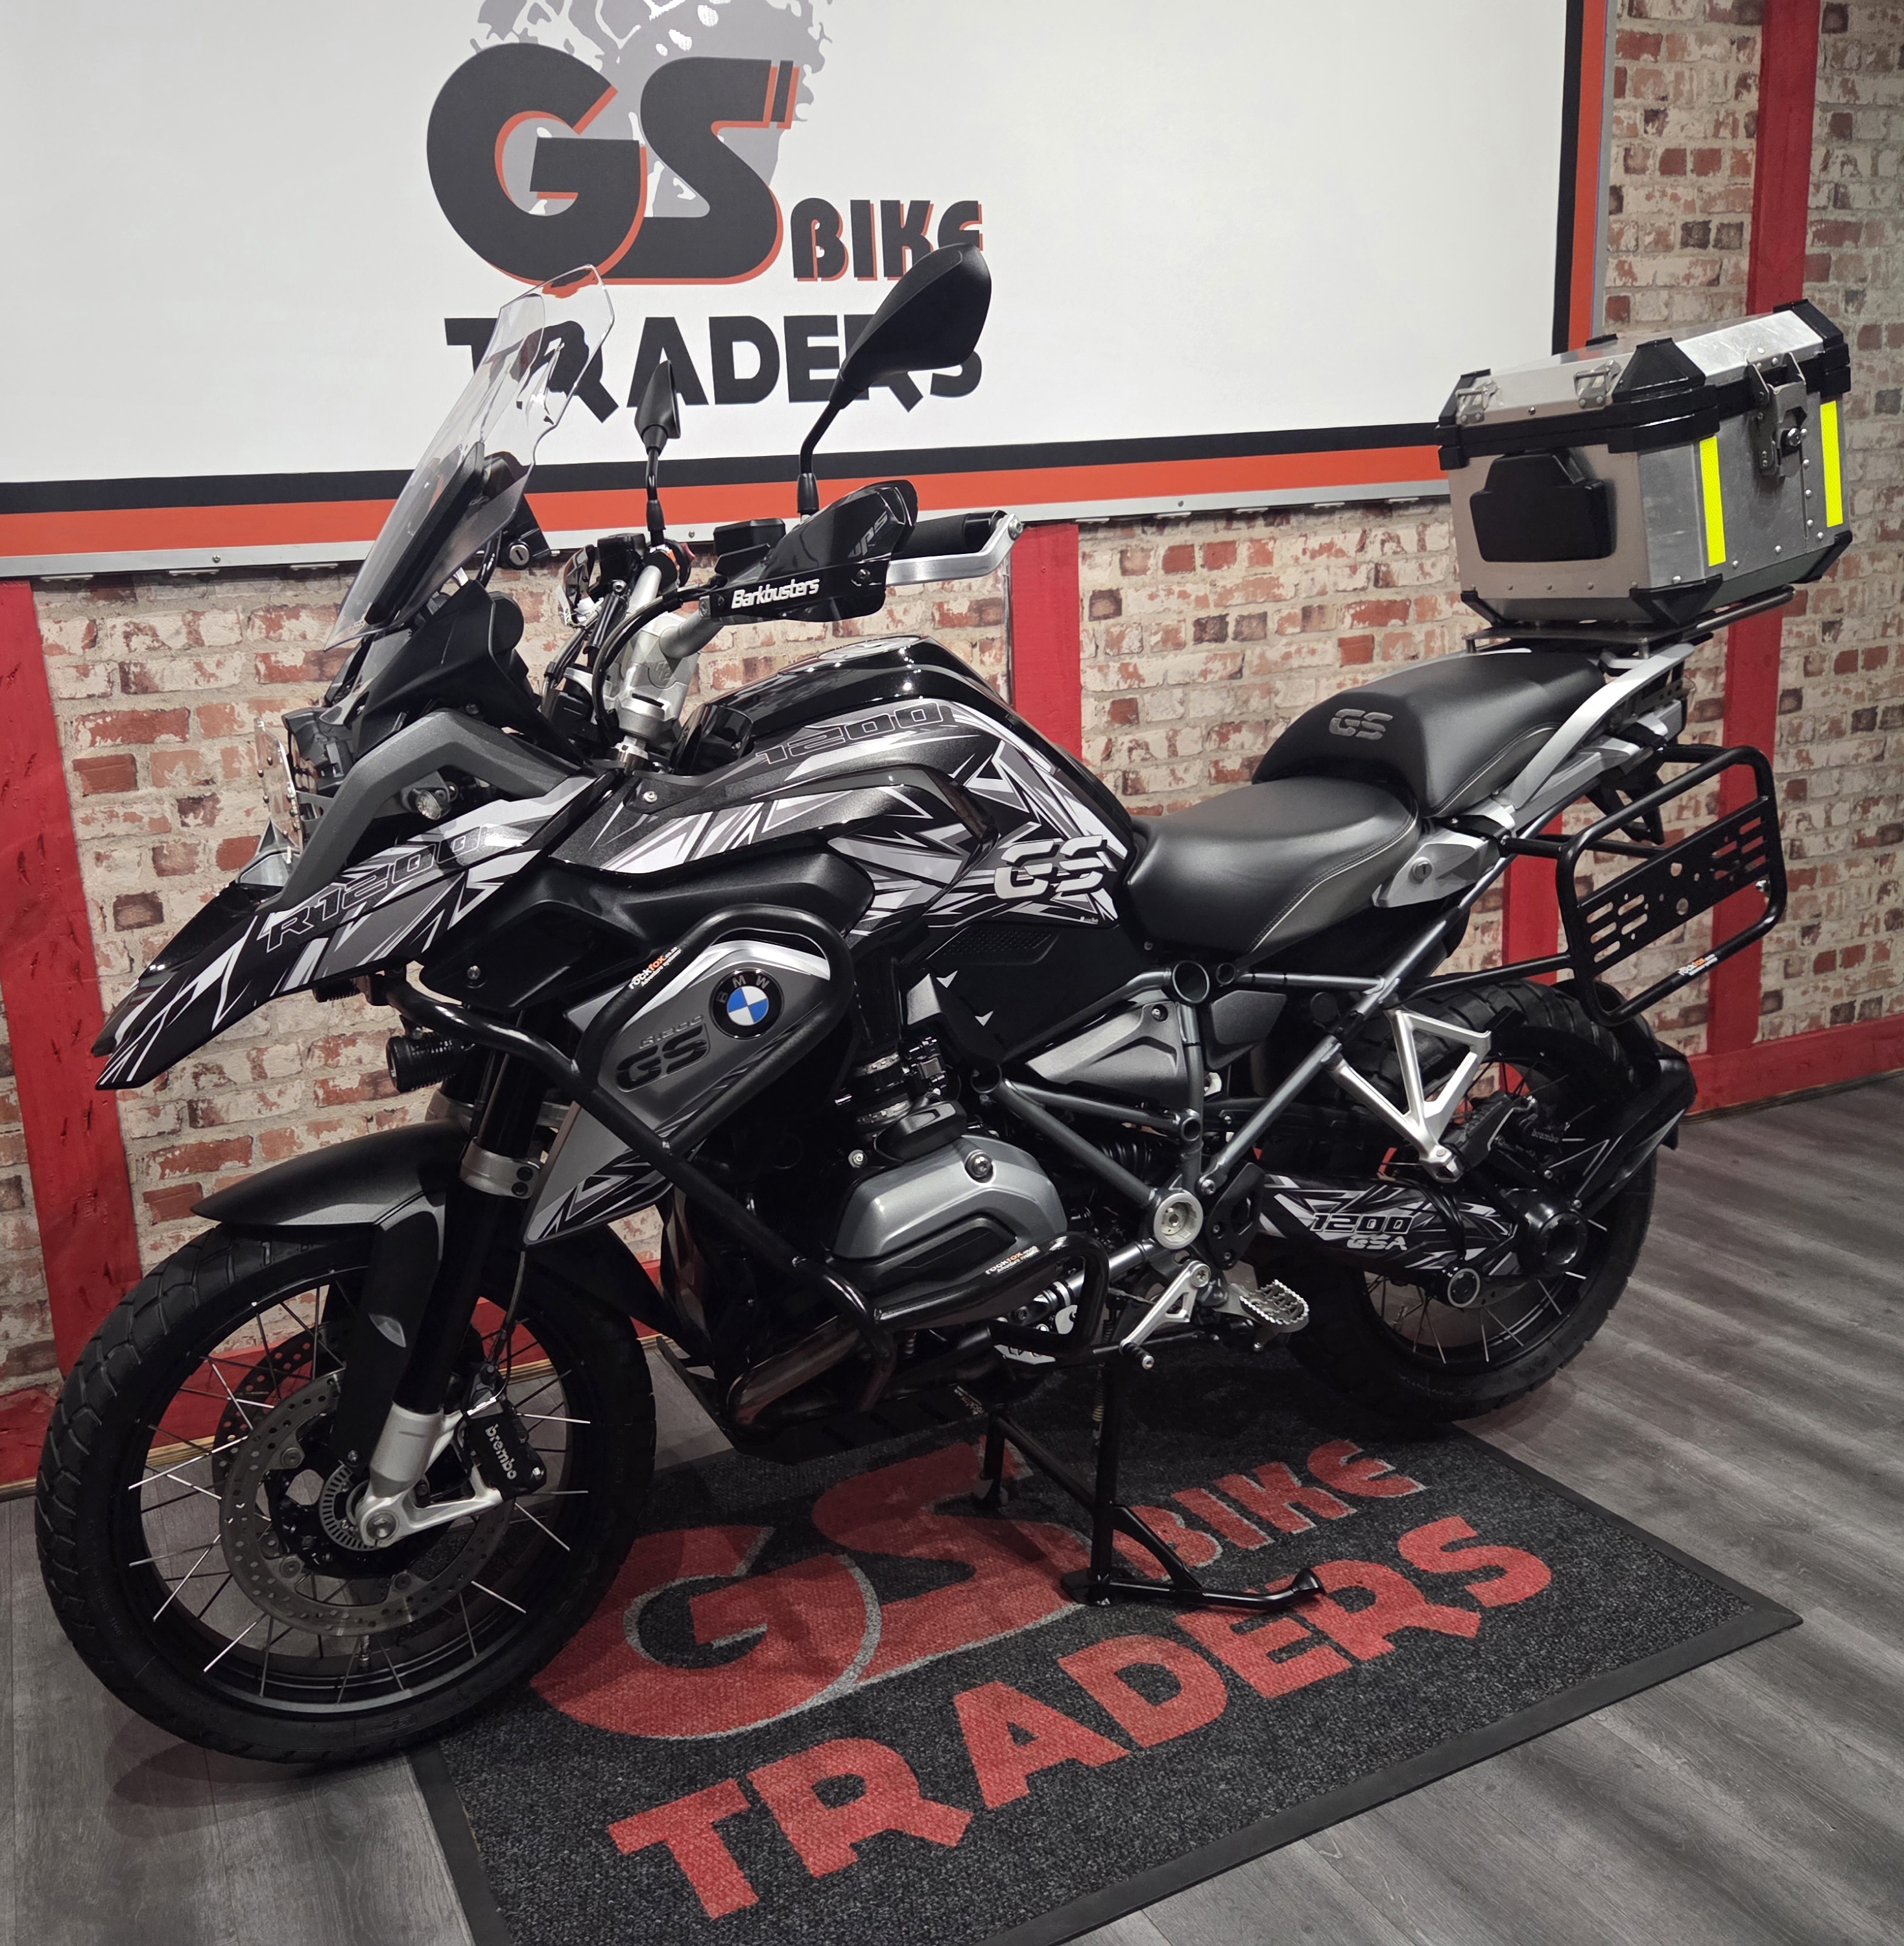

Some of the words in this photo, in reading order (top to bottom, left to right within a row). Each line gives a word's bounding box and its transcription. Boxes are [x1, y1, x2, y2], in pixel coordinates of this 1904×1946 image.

[426, 42, 800, 285] GS
[790, 197, 983, 282] BIKE
[731, 579, 820, 609] Barkbusters
[756, 701, 944, 765] 1200
[1329, 708, 1394, 740] GS
[265, 826, 482, 954] R1200
[994, 834, 1106, 900] GS
[715, 974, 770, 1004] BMW
[616, 1025, 708, 1092] GS
[1310, 1212, 1414, 1234] 1200
[1346, 1233, 1408, 1251] GSA
[485, 1423, 518, 1480] brembo
[1112, 1437, 1427, 1581] BIKE
[529, 1434, 1096, 1740] GS
[606, 1515, 1553, 1920] TRADERS
